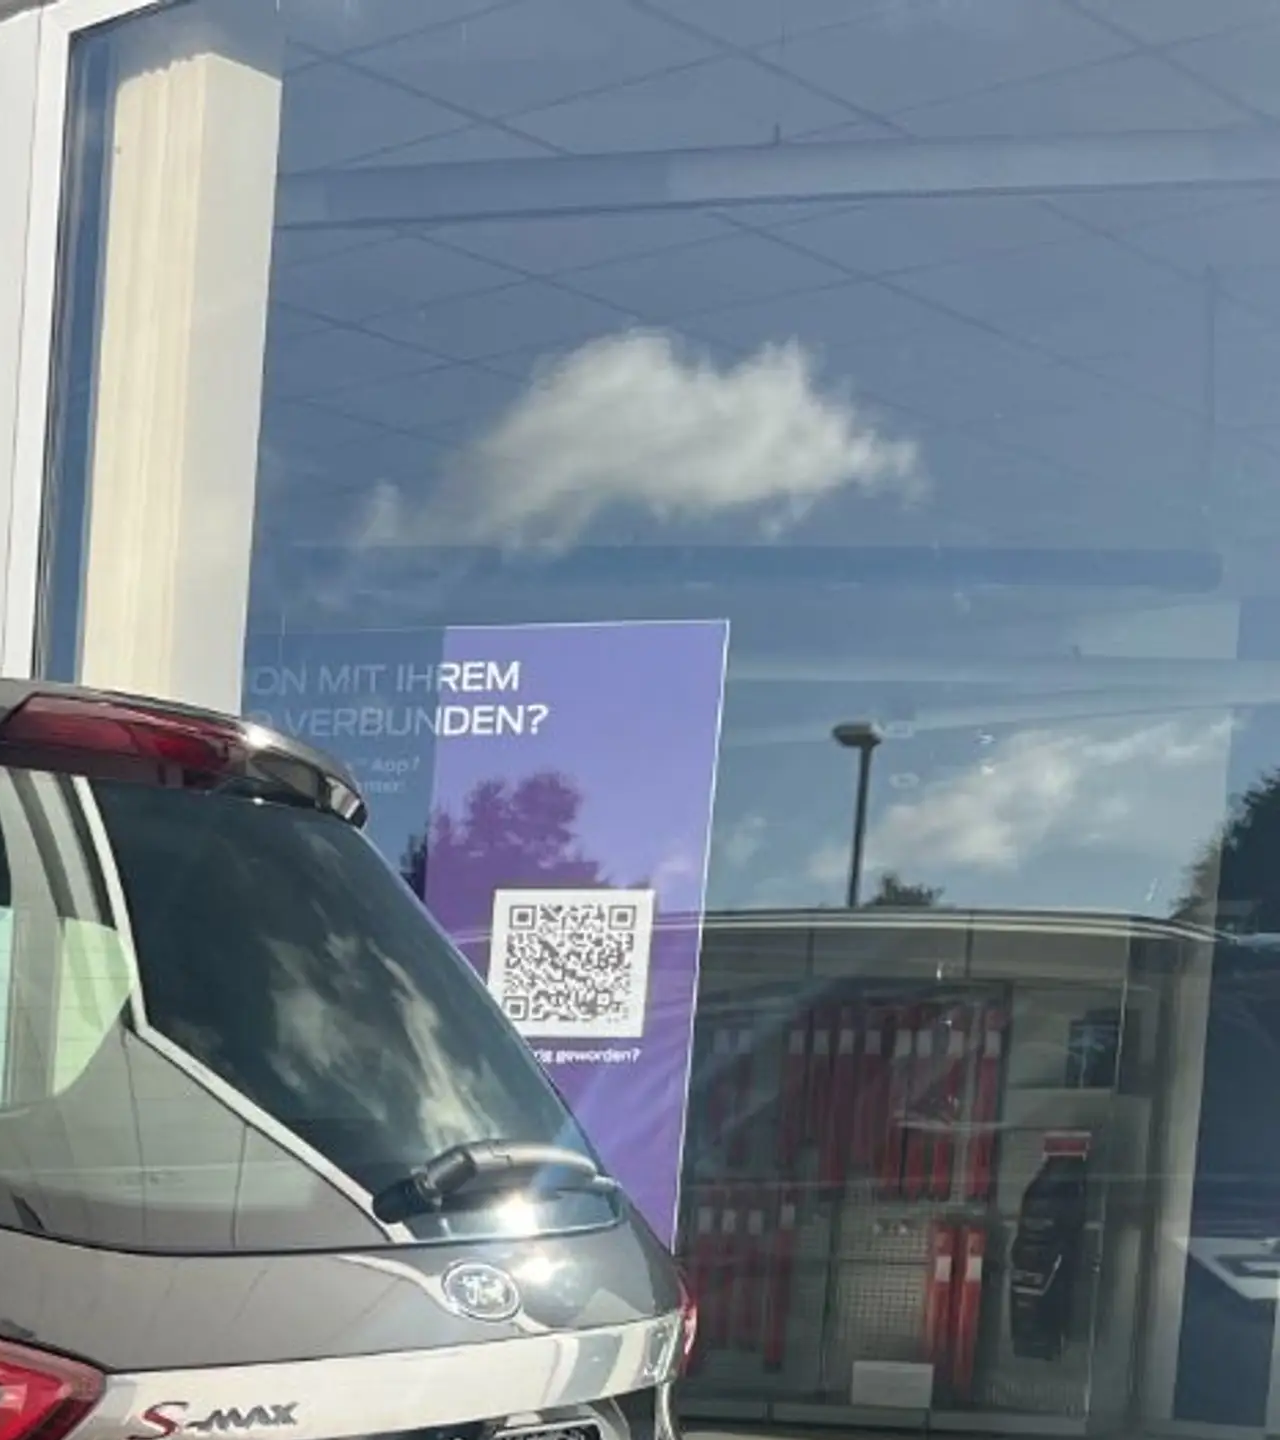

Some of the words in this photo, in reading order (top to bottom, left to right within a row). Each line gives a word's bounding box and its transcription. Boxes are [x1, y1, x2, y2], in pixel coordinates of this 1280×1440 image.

[318, 663, 385, 695] MIT
[396, 660, 522, 693] IHREM
[284, 704, 549, 737] VERBUNDEN?
